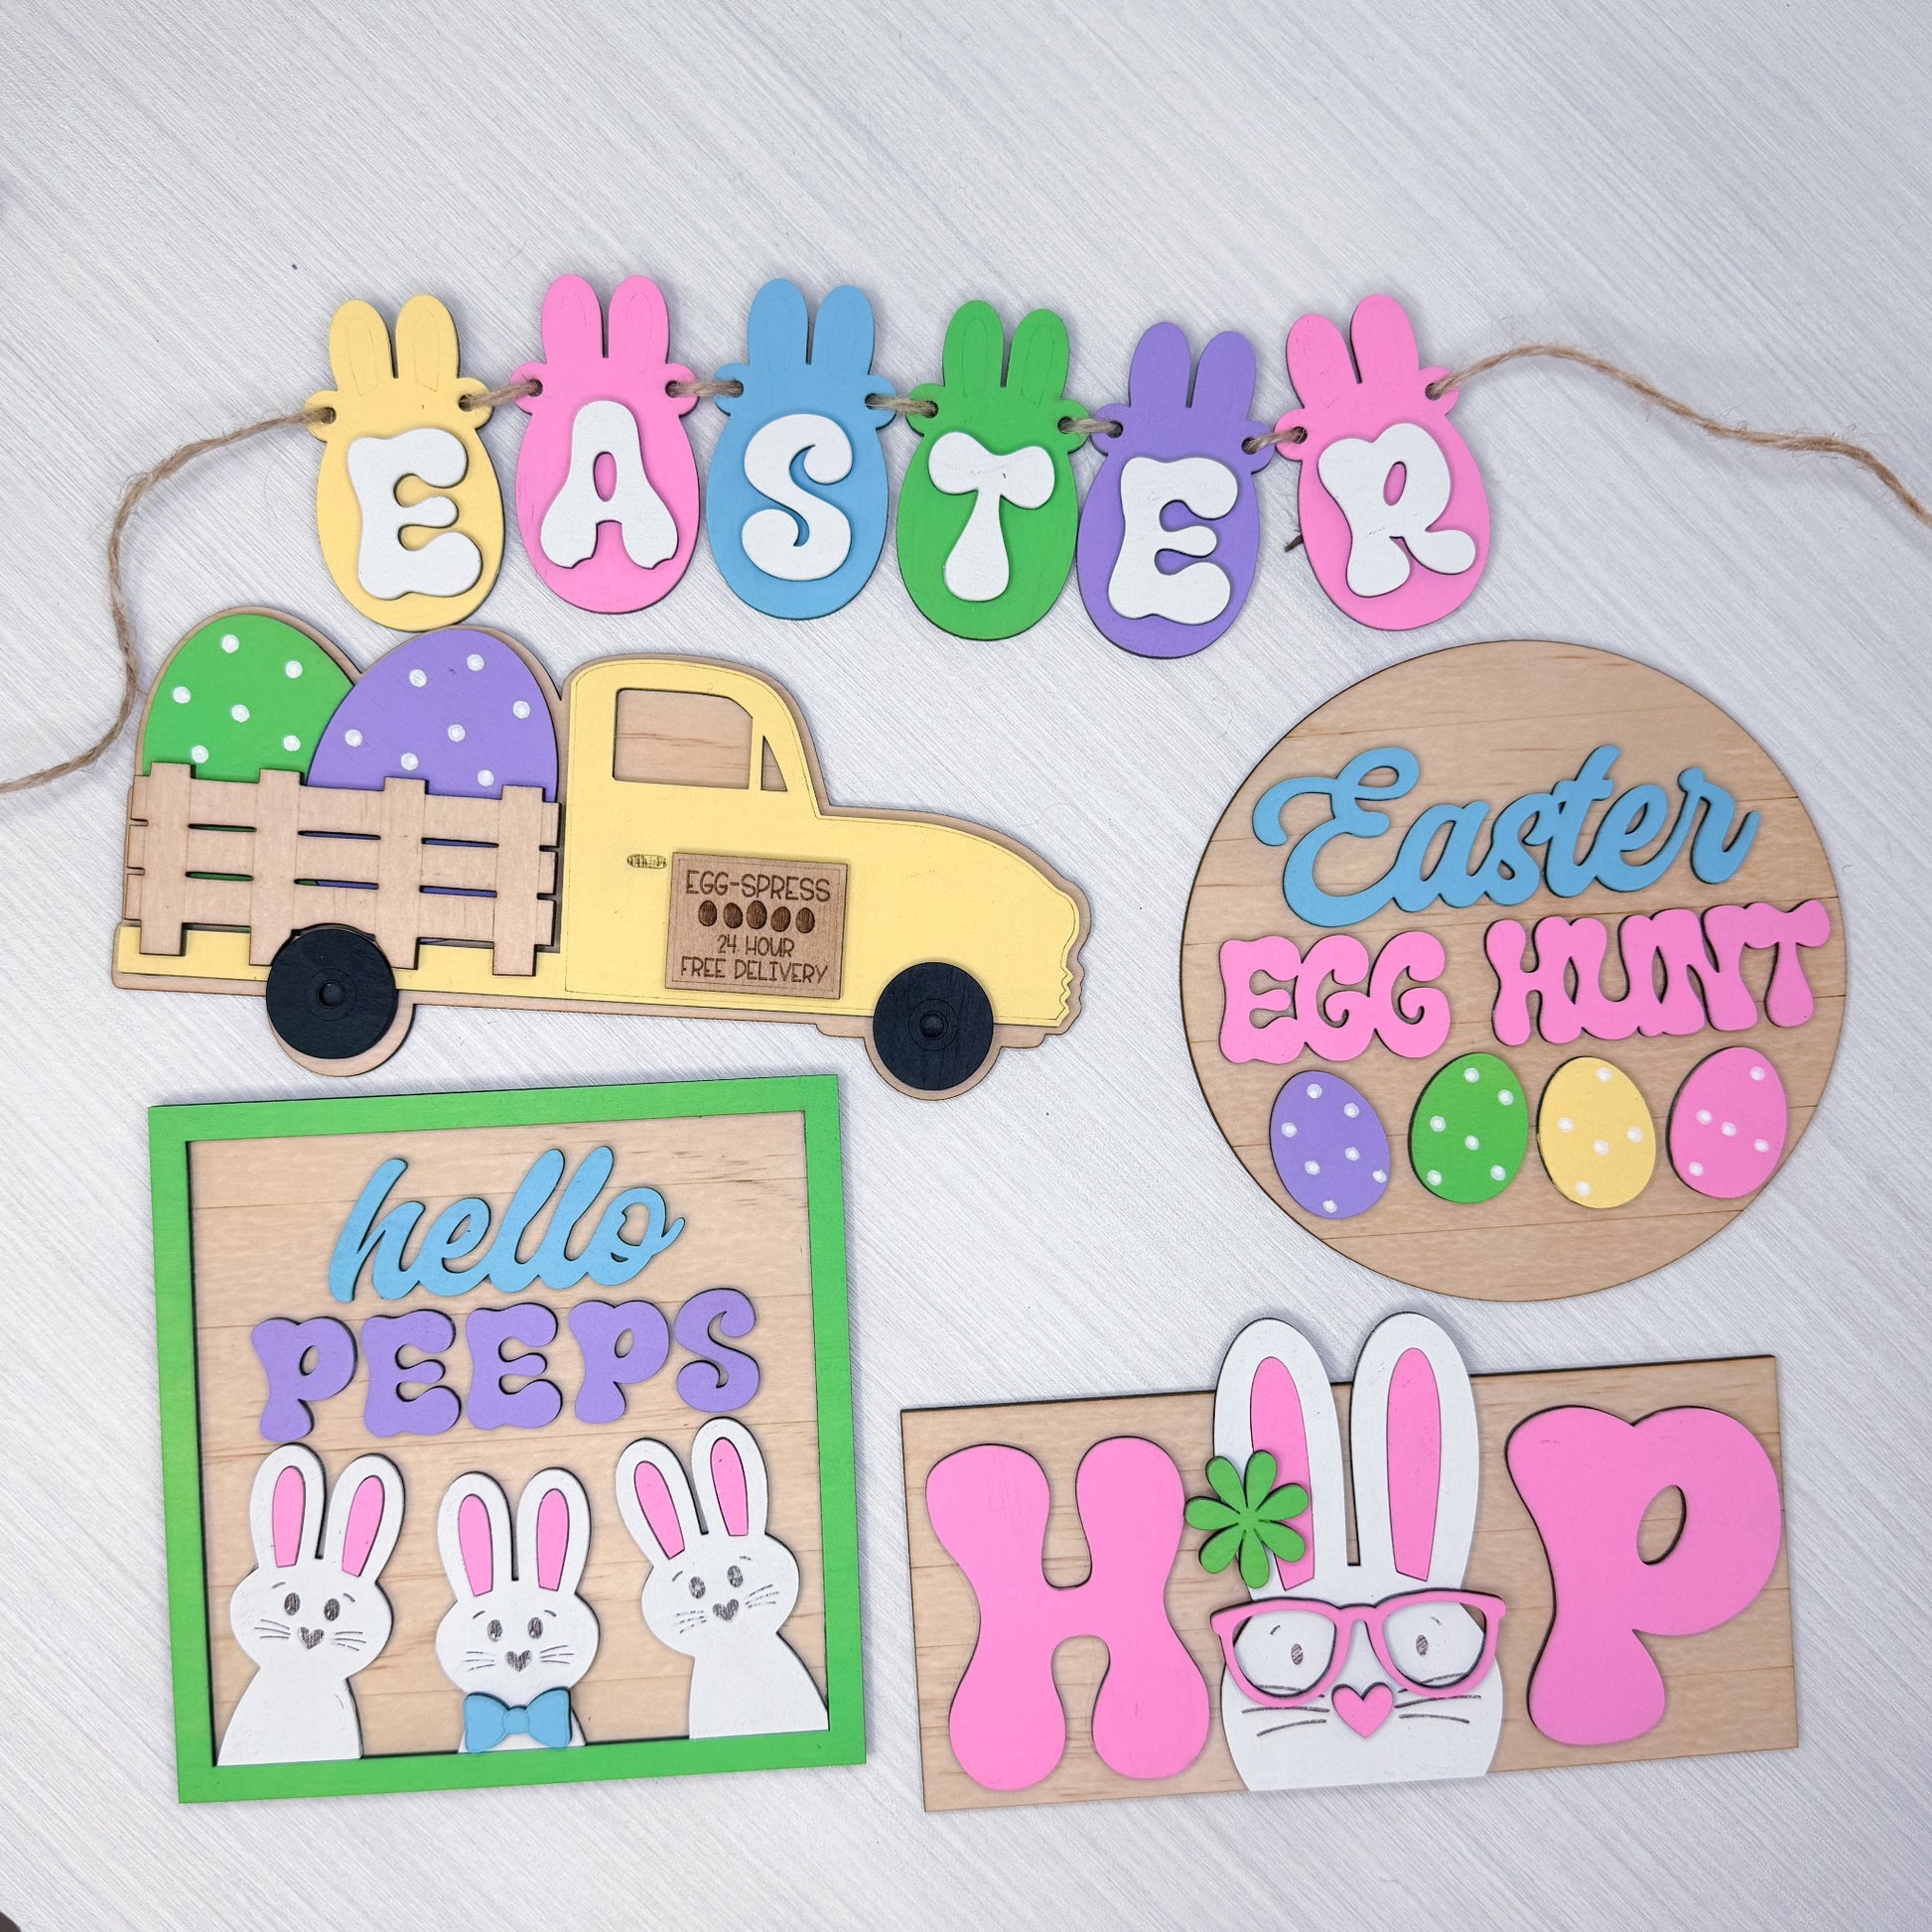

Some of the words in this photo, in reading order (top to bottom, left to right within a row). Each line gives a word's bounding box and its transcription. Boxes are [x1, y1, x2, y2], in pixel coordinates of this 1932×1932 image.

[346, 400, 1476, 625] EASTER
[685, 869, 831, 902] EGG-SPRESS
[1251, 745, 1760, 928] Easter
[680, 955, 727, 979] FREE
[734, 958, 829, 984] DELIVERY
[717, 933, 738, 954] 24
[745, 935, 795, 958] HOUR
[1218, 930, 1451, 1064] EGG
[1484, 899, 1831, 1046] HUNT
[328, 1145, 686, 1304] hello
[251, 1288, 760, 1443] PEEPS
